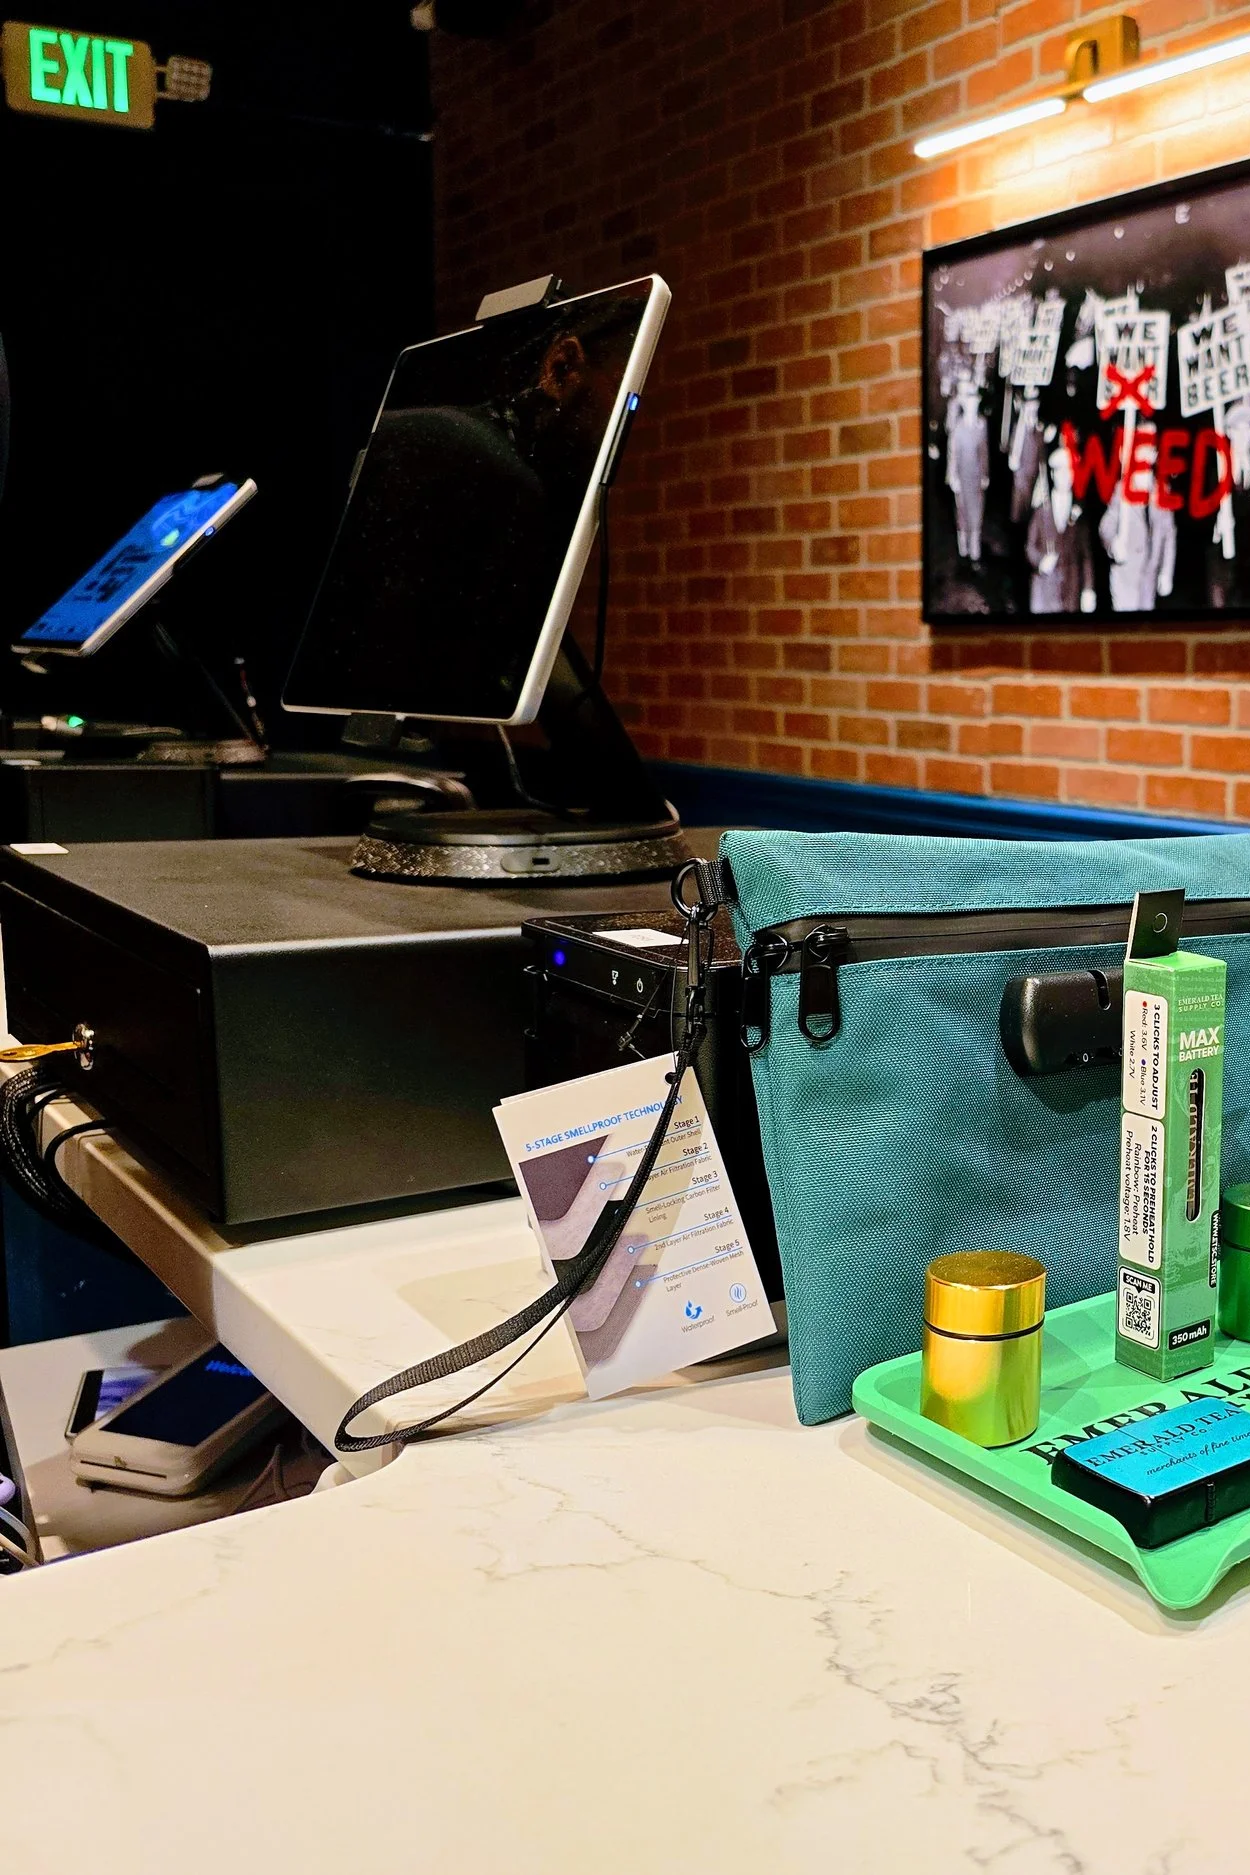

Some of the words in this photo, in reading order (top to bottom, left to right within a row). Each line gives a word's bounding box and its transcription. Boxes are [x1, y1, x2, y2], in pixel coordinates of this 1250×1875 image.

[29, 28, 134, 113] EXIT
[1116, 321, 1157, 341] WE
[1191, 313, 1238, 346] WE
[1186, 334, 1244, 377] WANT
[1186, 363, 1250, 408] BEER
[1061, 419, 1233, 520] WEED
[1153, 1003, 1161, 1011] 3
[1178, 995, 1210, 1006] EMERALD
[1210, 993, 1223, 1001] TEA
[1178, 1003, 1208, 1013] SUPPLY
[1152, 1012, 1160, 1053] CLICKS
[1179, 1026, 1220, 1051] MAX
[1152, 1053, 1160, 1067] TO
[1178, 1045, 1220, 1063] BATTERY
[1139, 1087, 1147, 1107] 3.1V
[1151, 1068, 1159, 1111] ADJUST
[673, 1117, 694, 1130] Stage
[694, 1115, 700, 1123] 1
[1151, 1125, 1158, 1133] 2
[525, 1133, 564, 1153] 5-STAGE
[563, 1114, 622, 1140] SMELLPROOF
[670, 1133, 686, 1143] Outer
[687, 1129, 702, 1138] Shell
[682, 1145, 702, 1157] Stage
[703, 1142, 708, 1150] 2
[1125, 1130, 1134, 1171] Preheat
[660, 1167, 669, 1176] Air
[668, 1159, 695, 1174] Filtration
[694, 1154, 712, 1167] Fabric
[1134, 1142, 1142, 1194] Rainbow:
[692, 1173, 713, 1185] Stage
[713, 1170, 718, 1178] 3
[1144, 1173, 1150, 1186] 15
[1149, 1171, 1157, 1186] TO
[685, 1188, 706, 1200] Carbon
[1123, 1171, 1131, 1216] voltage:
[703, 1210, 724, 1221] Stage
[724, 1206, 729, 1214] 4
[1132, 1194, 1140, 1236] Preheat
[1142, 1186, 1150, 1235] SECONDS
[1148, 1187, 1156, 1233] PREHEAT
[654, 1241, 667, 1250] 2nd
[665, 1236, 683, 1248] Layer
[682, 1233, 691, 1242] Air
[690, 1225, 717, 1238] Filtration
[716, 1219, 734, 1229] Fabric
[1123, 1218, 1131, 1242] 1.8V
[714, 1242, 734, 1254] Stage
[734, 1239, 740, 1247] 5
[1147, 1233, 1155, 1263] HOLD
[663, 1269, 692, 1283] Protective
[729, 1250, 745, 1260] Mesh
[666, 1282, 682, 1294] Layer
[1125, 1275, 1142, 1289] SCAN
[1141, 1280, 1153, 1292] ME
[681, 1315, 715, 1333] Waterproof
[1171, 1332, 1189, 1346] 350
[1189, 1325, 1207, 1340] mAh
[1086, 1423, 1196, 1467] EMERALD
[1195, 1407, 1242, 1426] TEA
[1139, 1436, 1185, 1456] SUPPLY
[1146, 1451, 1198, 1476] merchants
[1199, 1444, 1210, 1456] of
[1210, 1439, 1230, 1453] fine
